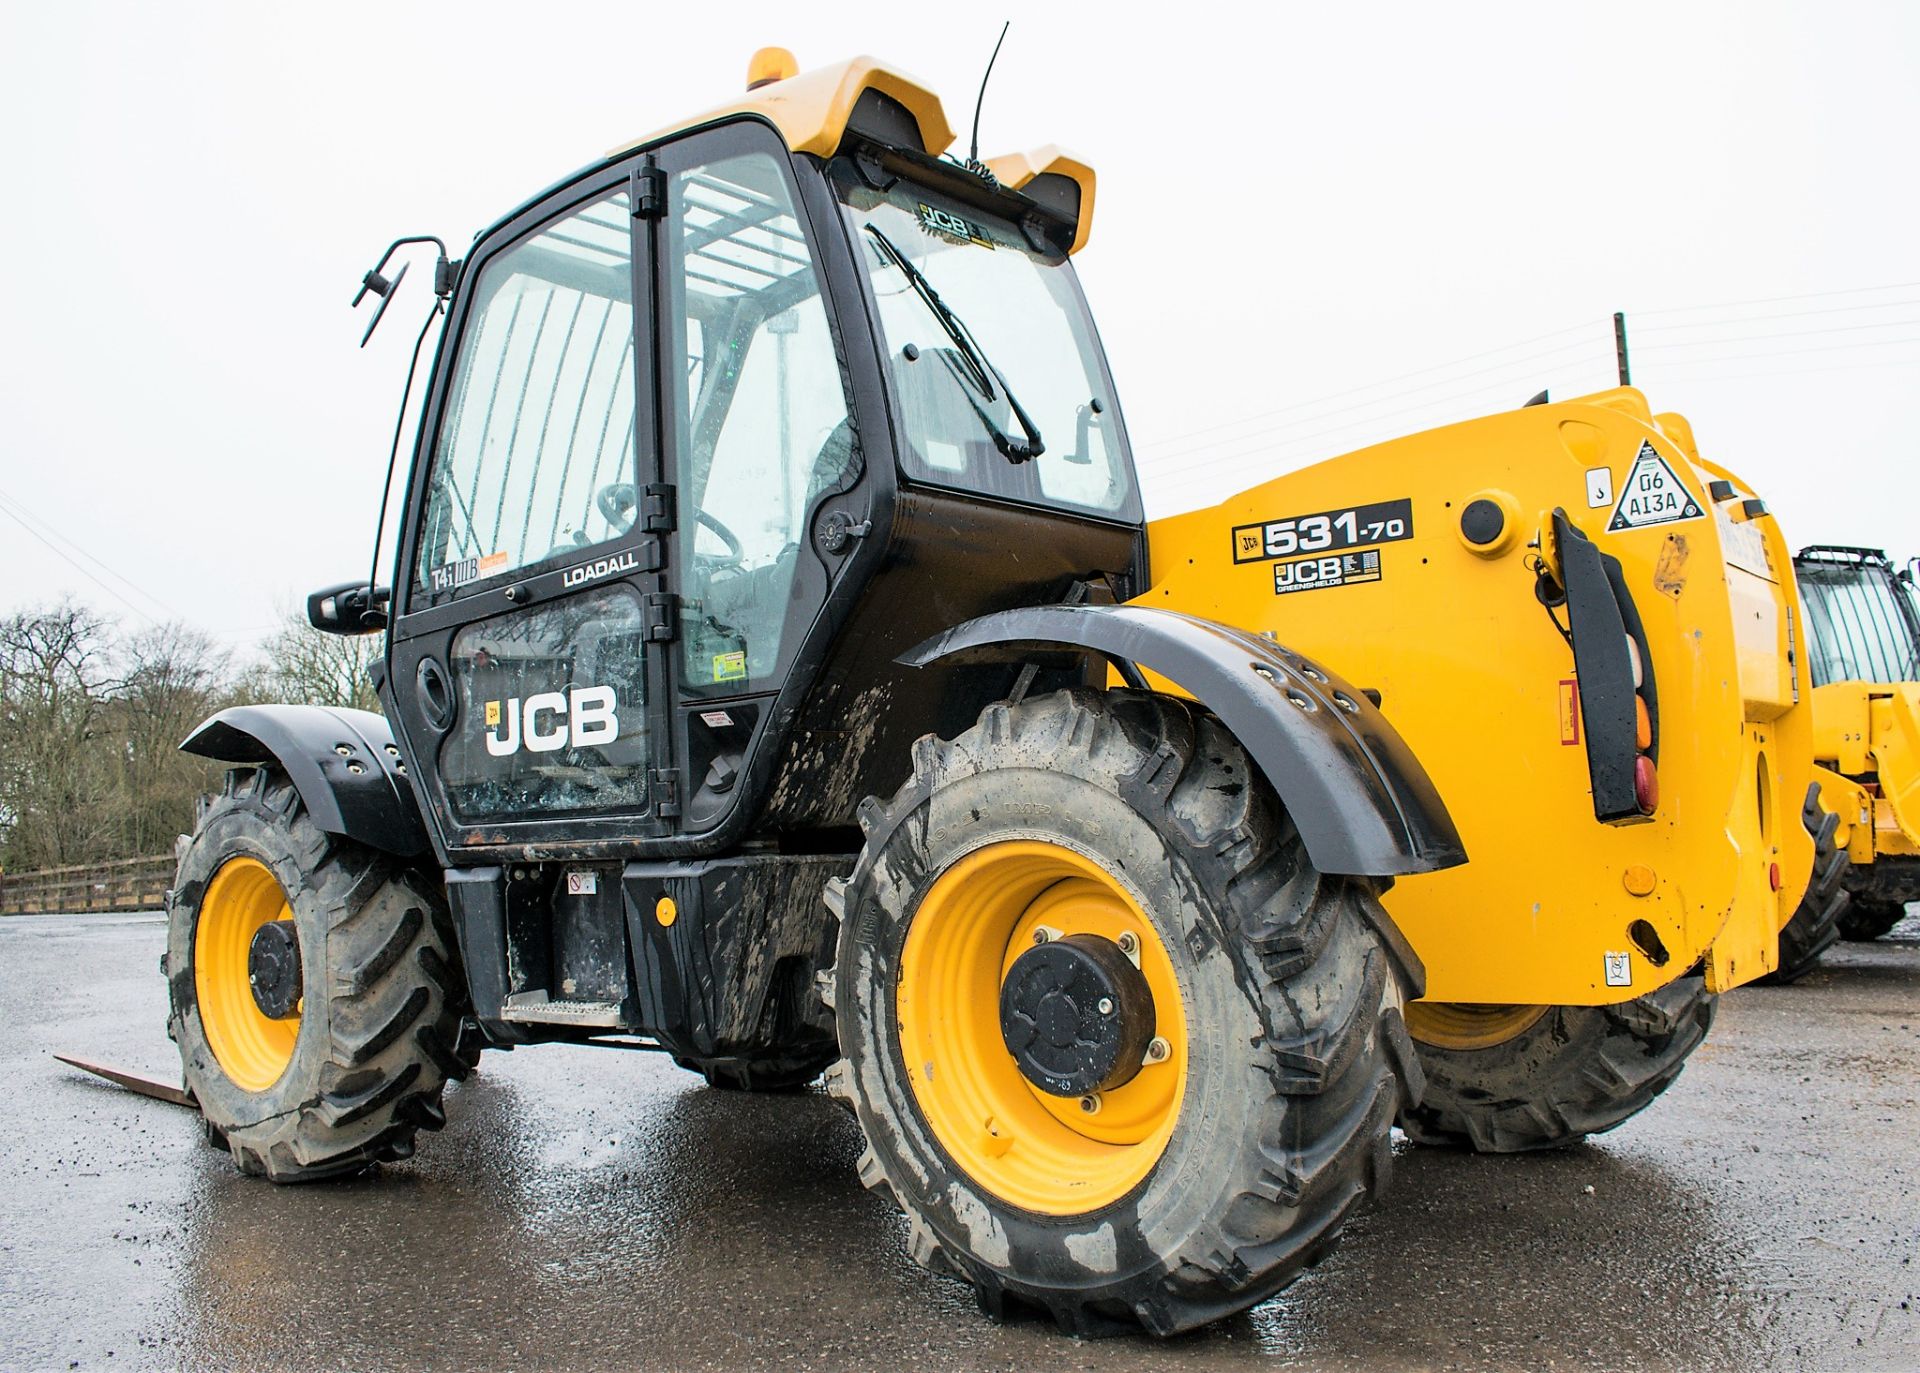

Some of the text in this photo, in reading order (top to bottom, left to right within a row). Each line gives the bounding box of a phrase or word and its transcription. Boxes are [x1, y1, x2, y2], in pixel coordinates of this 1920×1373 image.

[923, 206, 969, 235] JCB
[1265, 511, 1404, 556] 531-70
[563, 552, 639, 588] LOADALL
[1276, 557, 1342, 586] JCB
[1277, 577, 1343, 594] GREENSHIELDS
[486, 685, 619, 757] JCB
